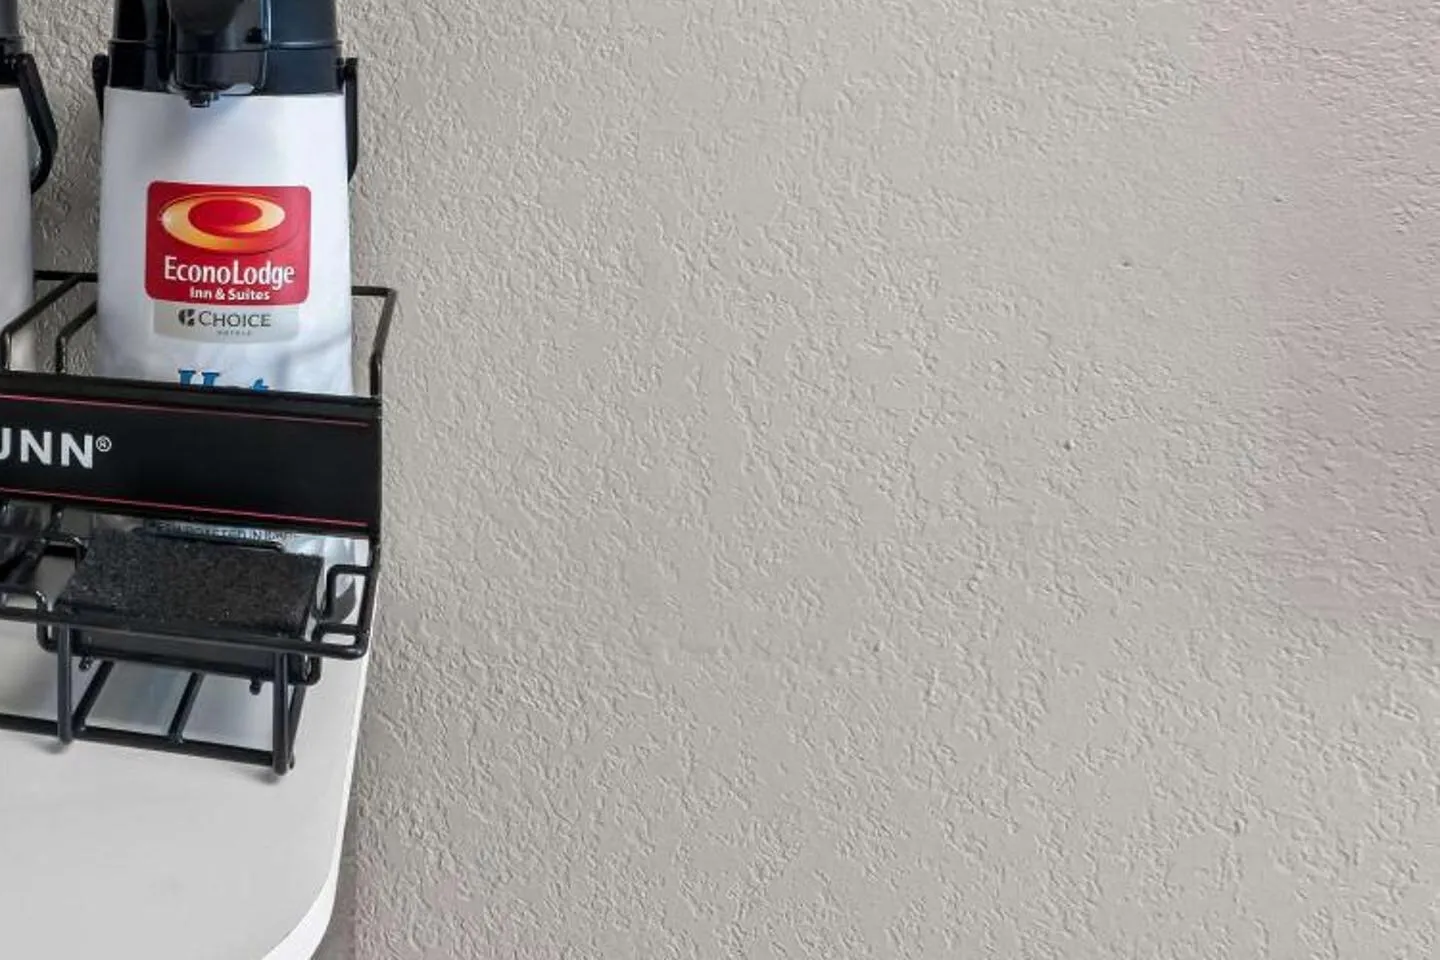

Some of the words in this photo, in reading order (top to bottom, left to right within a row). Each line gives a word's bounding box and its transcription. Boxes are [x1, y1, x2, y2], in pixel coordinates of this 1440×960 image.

[164, 255, 295, 291] EconoLodge
[189, 286, 213, 299] Inn
[214, 287, 226, 300] &
[227, 287, 271, 301] Suites
[198, 310, 272, 328] CHOICE
